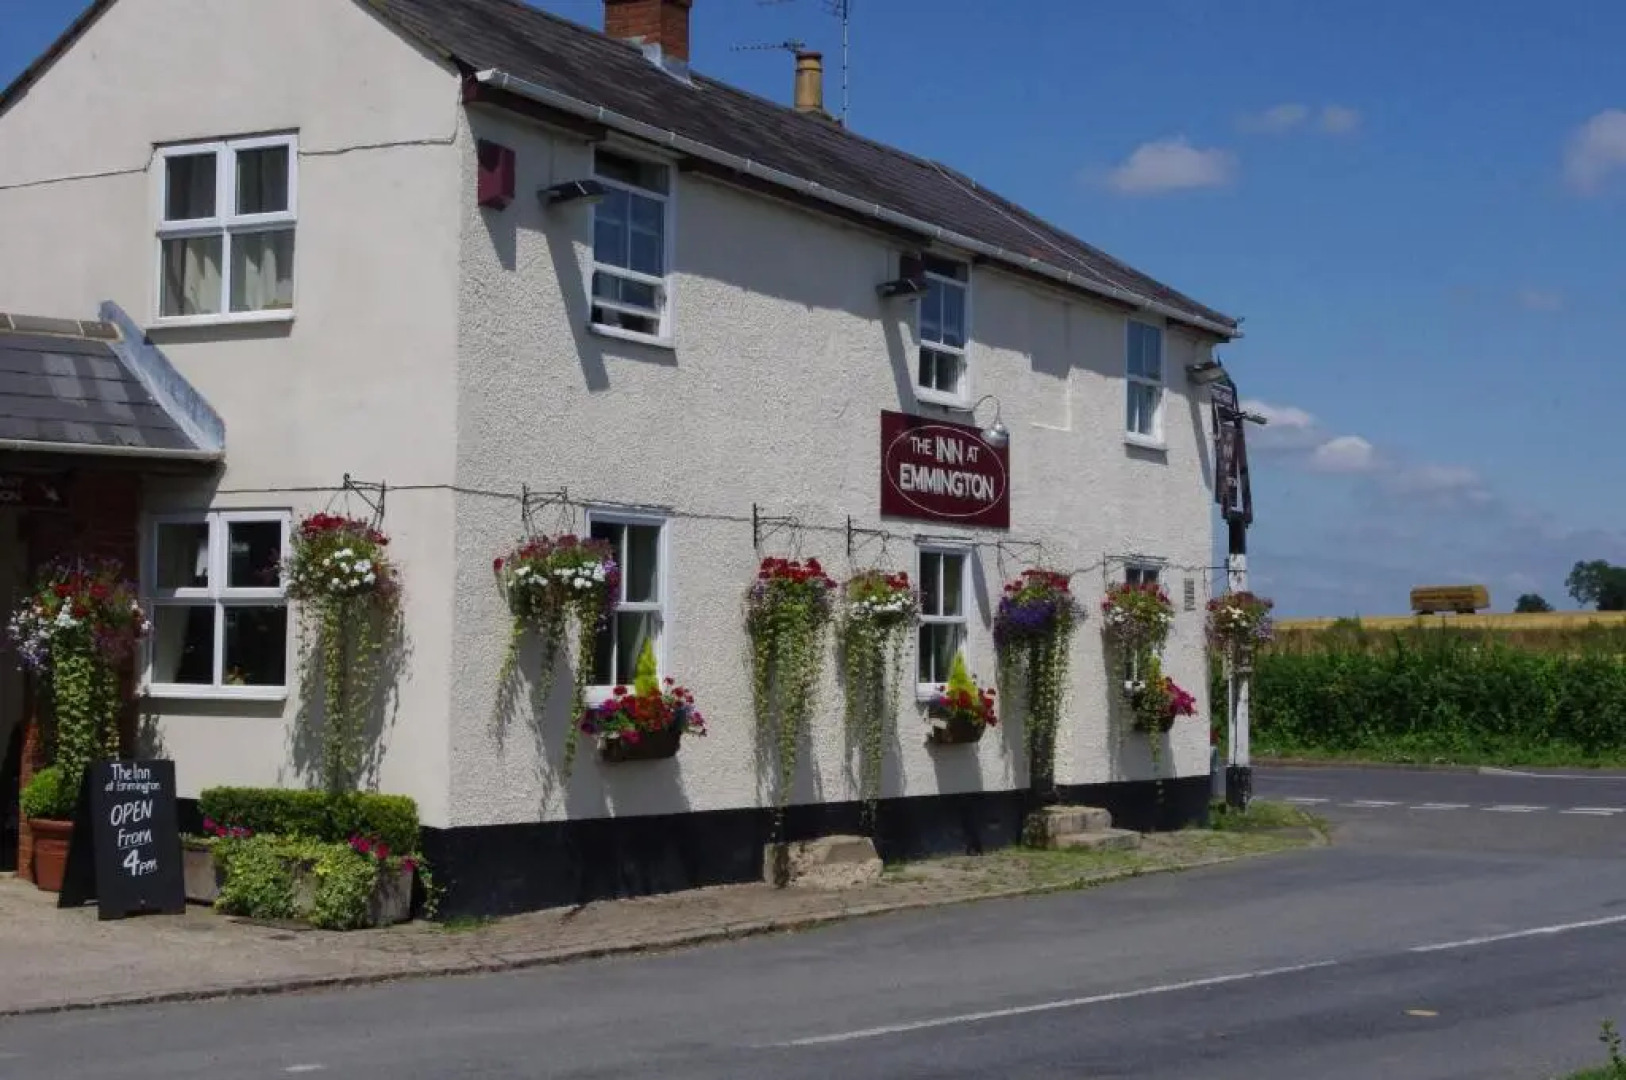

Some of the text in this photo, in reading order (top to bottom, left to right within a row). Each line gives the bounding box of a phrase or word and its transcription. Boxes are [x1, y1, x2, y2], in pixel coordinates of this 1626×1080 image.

[909, 435, 979, 465] THE INN AT
[899, 463, 995, 501] EMMINGTON
[110, 762, 150, 780] The Inn
[110, 798, 153, 826] OPEN
